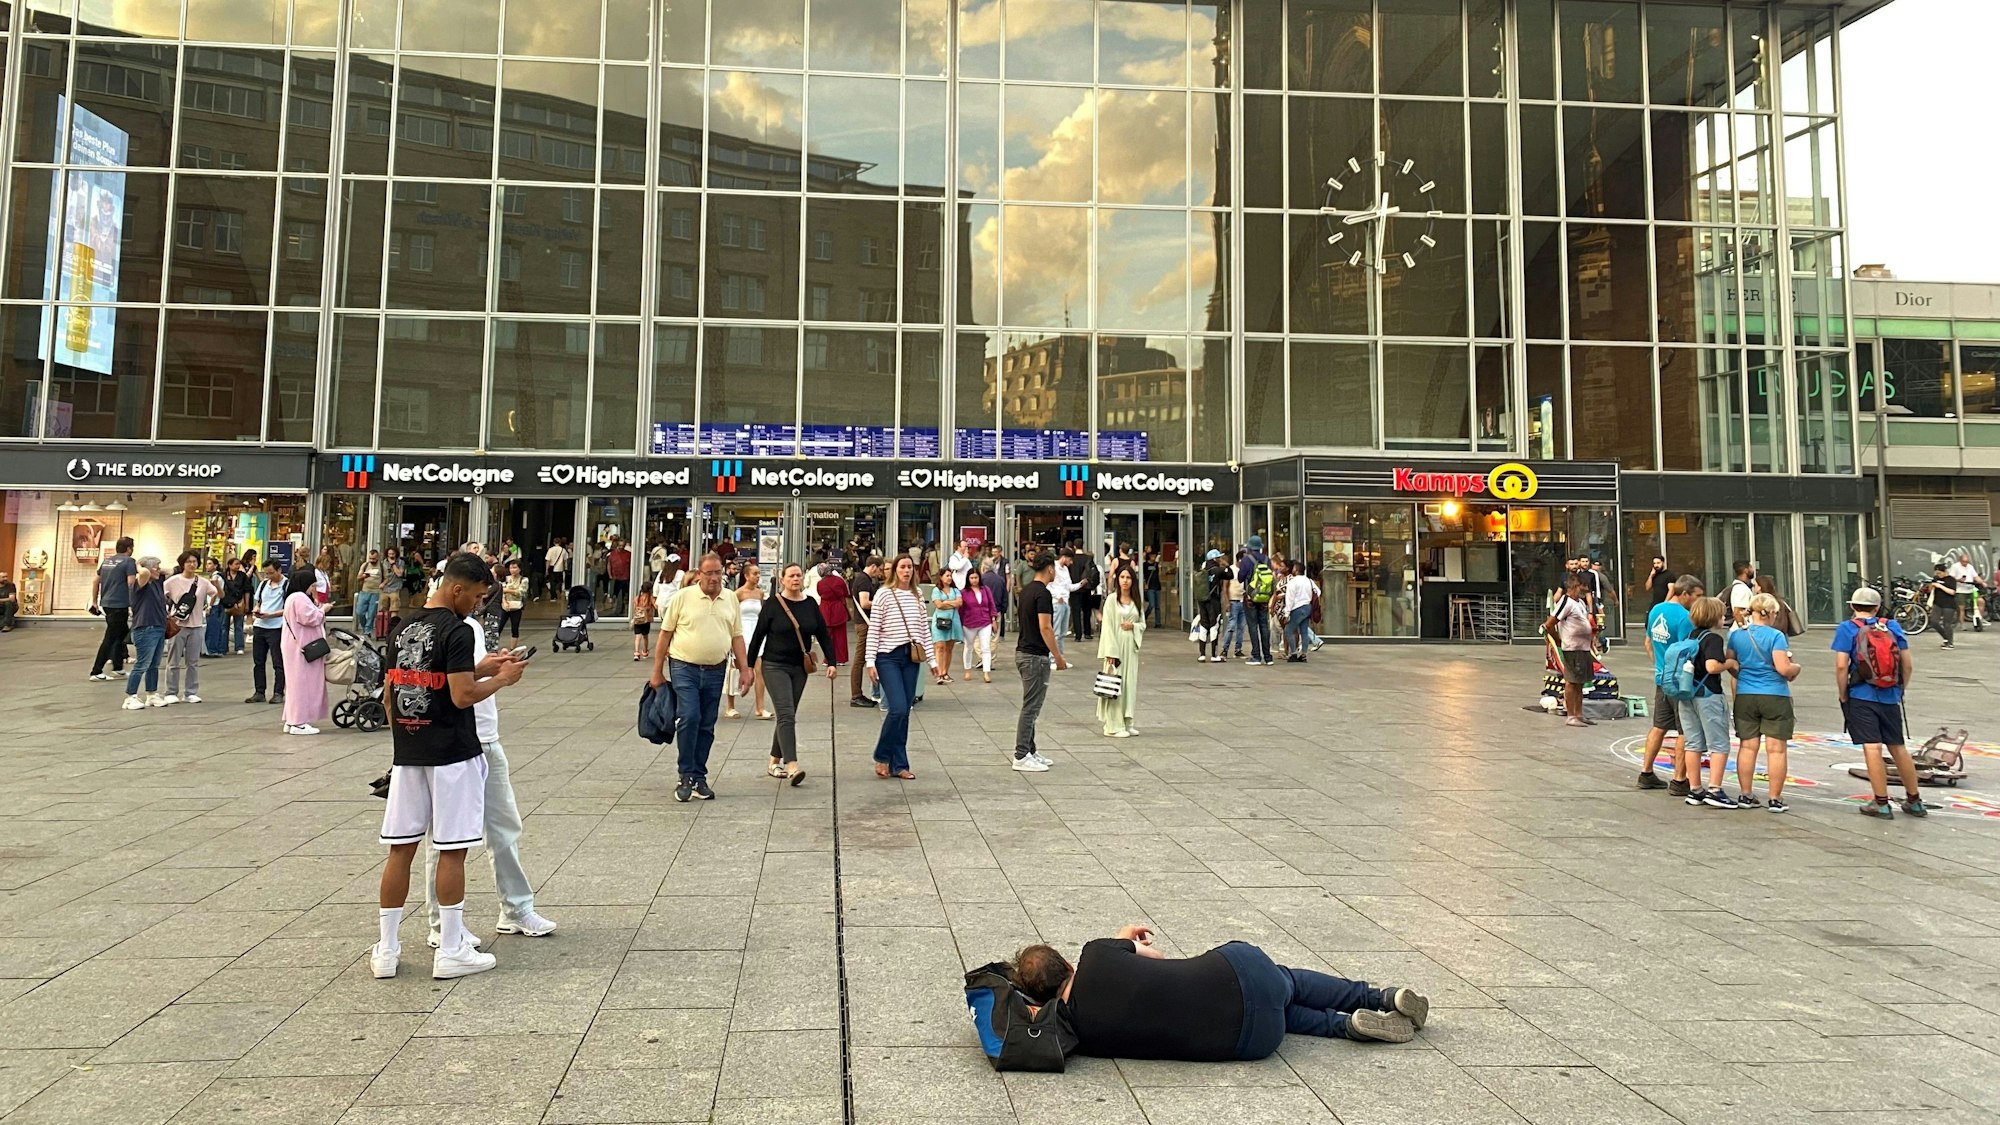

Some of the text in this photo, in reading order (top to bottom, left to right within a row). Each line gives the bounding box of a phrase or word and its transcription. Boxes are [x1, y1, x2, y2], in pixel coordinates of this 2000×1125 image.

[73, 140, 95, 159] deinen
[84, 130, 102, 148] beste
[102, 140, 116, 156] Plus
[1896, 292, 1932, 307] Dior
[1758, 369, 1896, 399] DUGAS
[96, 463, 222, 477] THE BODY SHOP
[383, 463, 514, 486] NetCologne
[576, 466, 690, 488] Highspeed
[751, 467, 874, 490] NetCologne
[933, 470, 1039, 492] Highspeed
[1096, 472, 1214, 495] NetCologne
[1393, 468, 1485, 497] Kamps
[806, 511, 839, 519] omation
